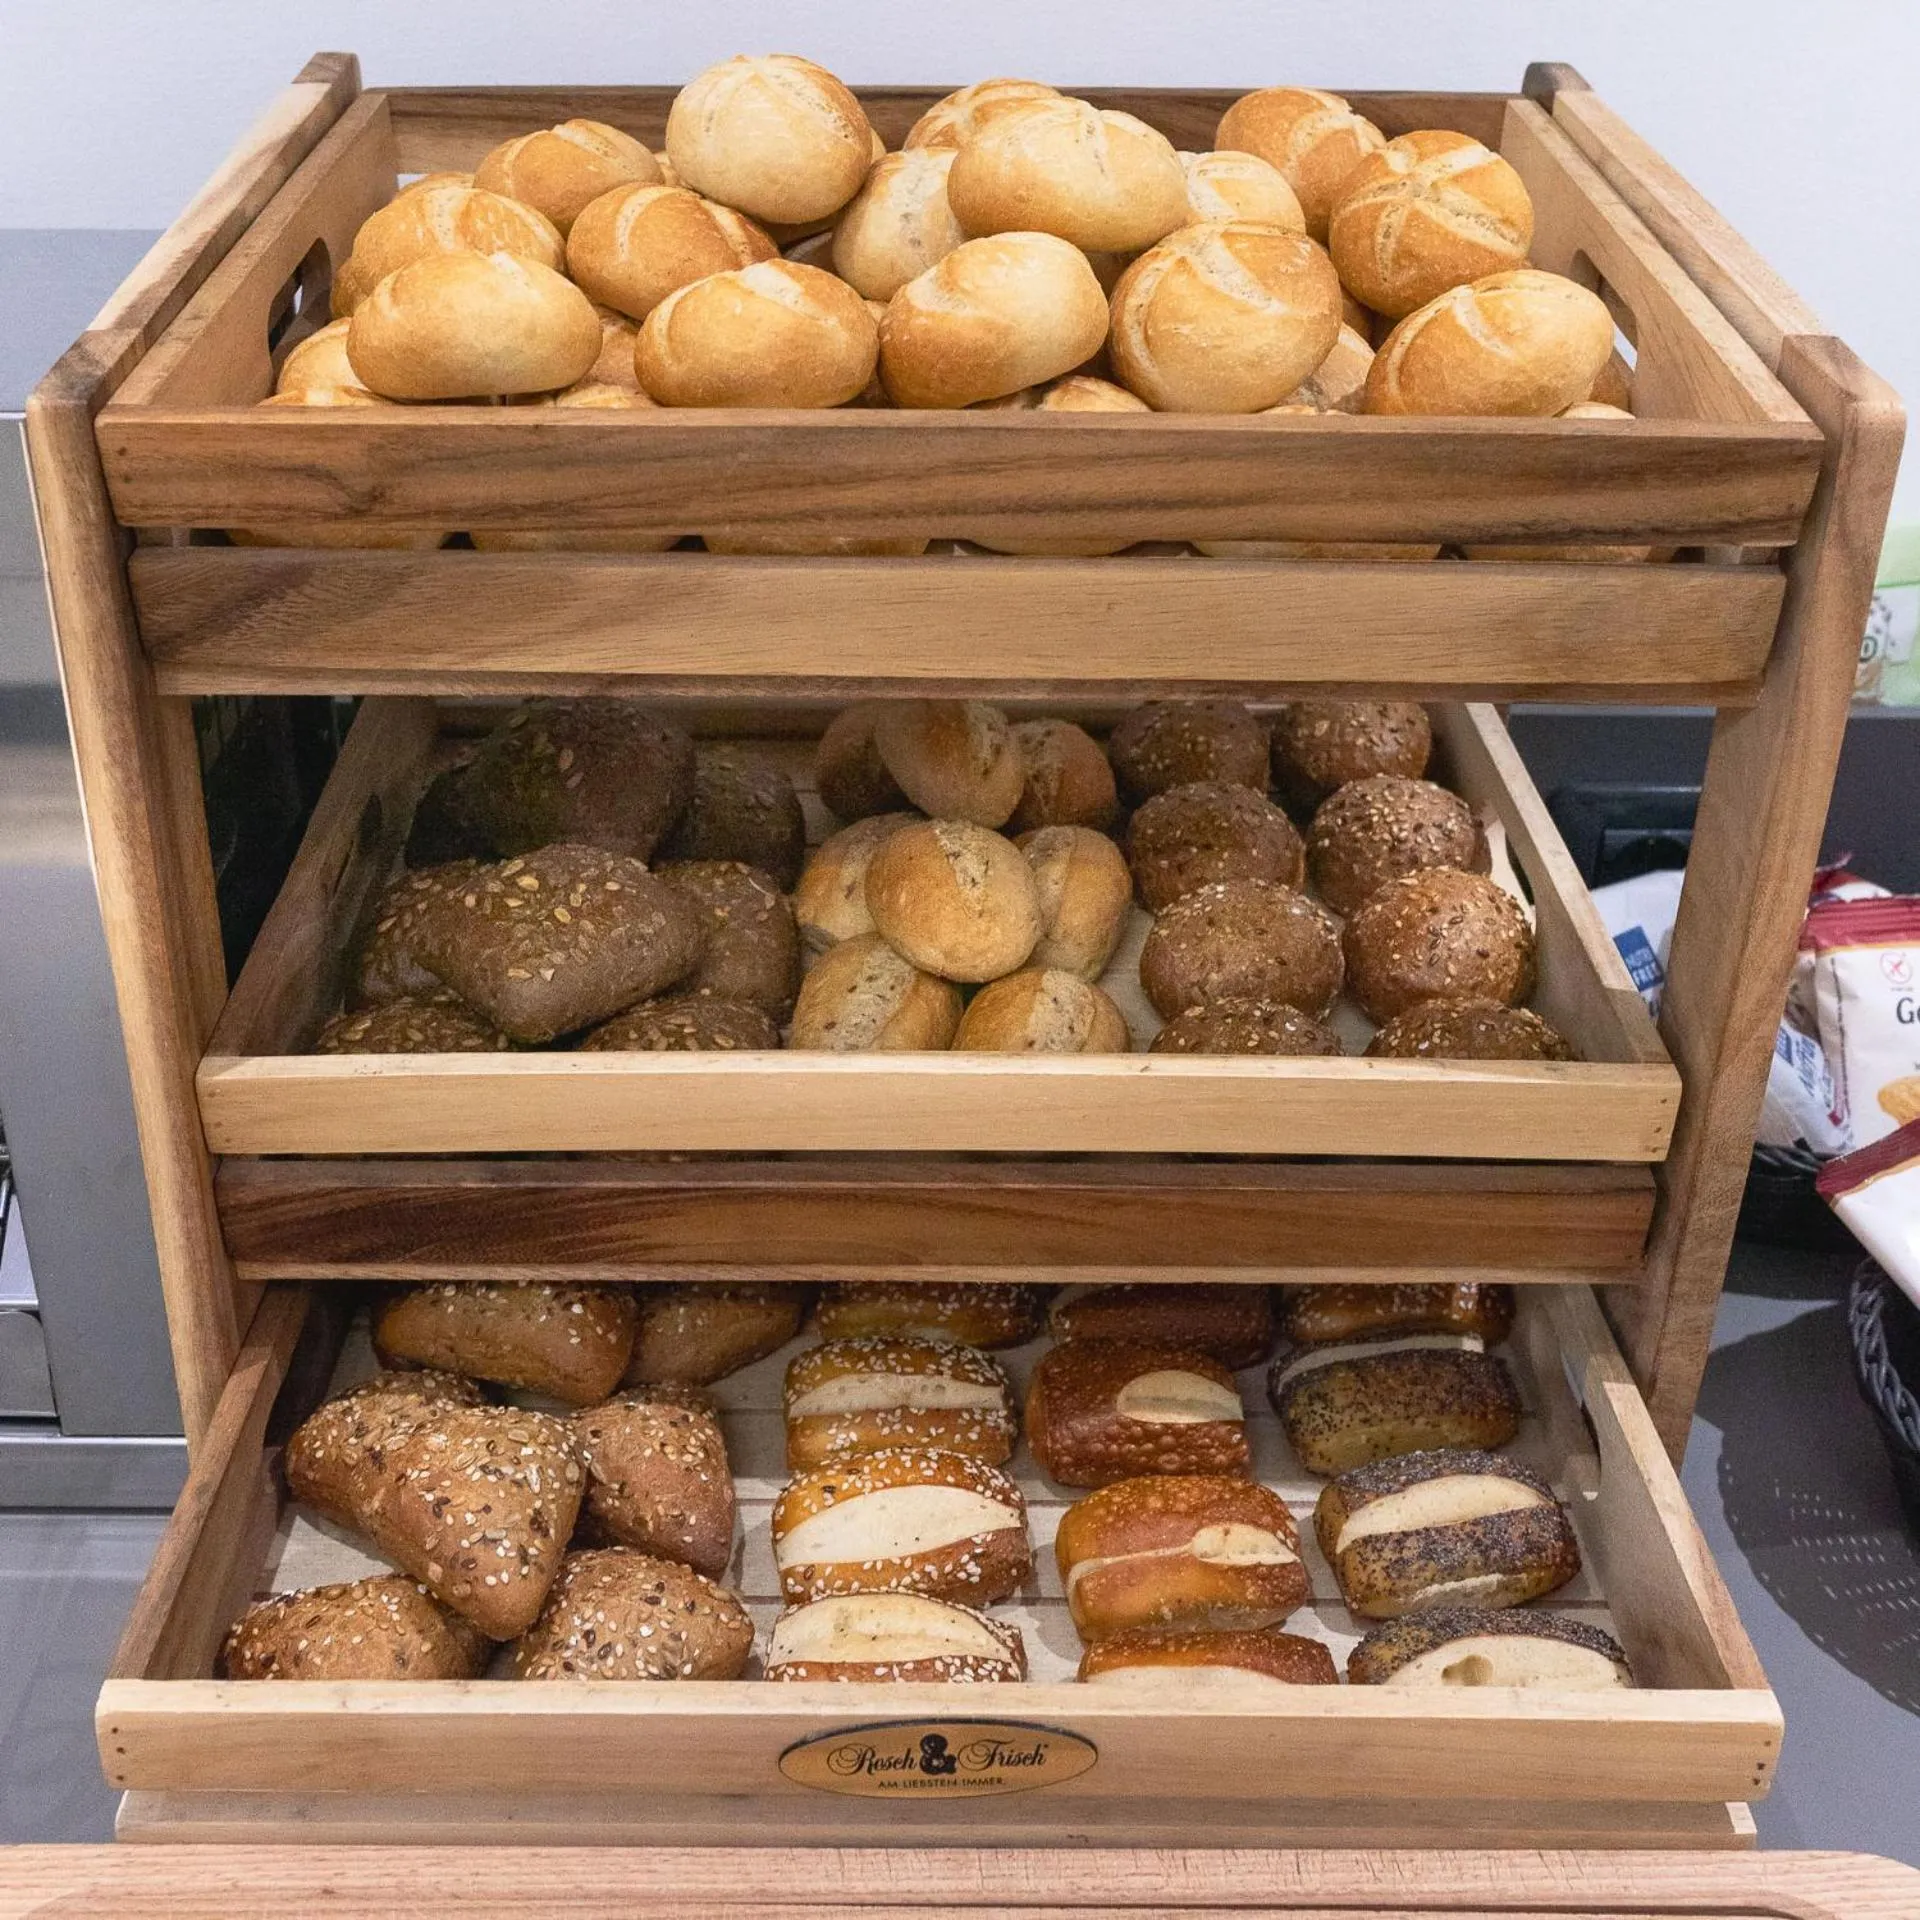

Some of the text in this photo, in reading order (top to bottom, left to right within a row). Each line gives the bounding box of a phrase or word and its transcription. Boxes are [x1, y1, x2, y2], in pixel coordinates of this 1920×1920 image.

[920, 1733, 957, 1775] &
[957, 1738, 1048, 1772] Frisch
[878, 1780, 899, 1789] AM
[903, 1778, 957, 1789] LIEBSTEN
